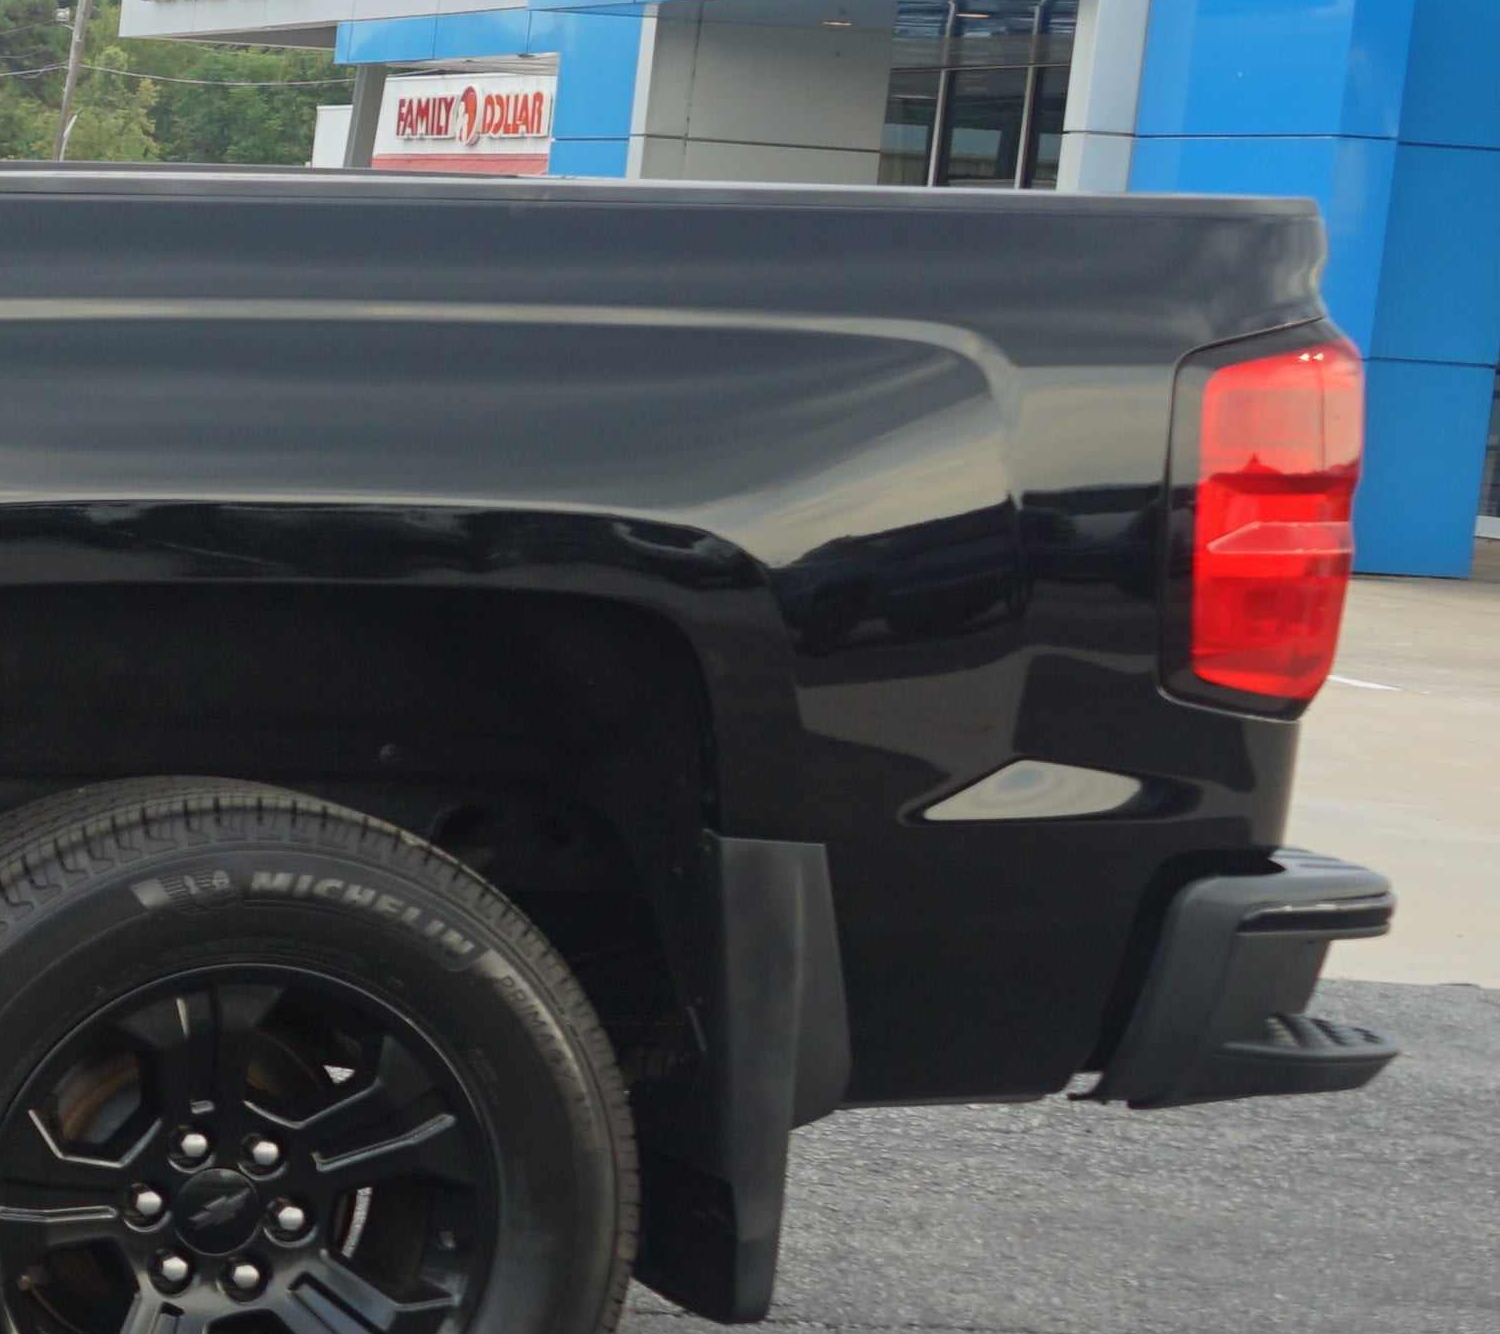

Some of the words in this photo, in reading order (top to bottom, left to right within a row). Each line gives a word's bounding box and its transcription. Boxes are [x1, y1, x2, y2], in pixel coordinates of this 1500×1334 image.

[396, 97, 454, 136] FAMILY
[481, 91, 545, 135] DOLLAR
[250, 870, 476, 957] MICHELIN
